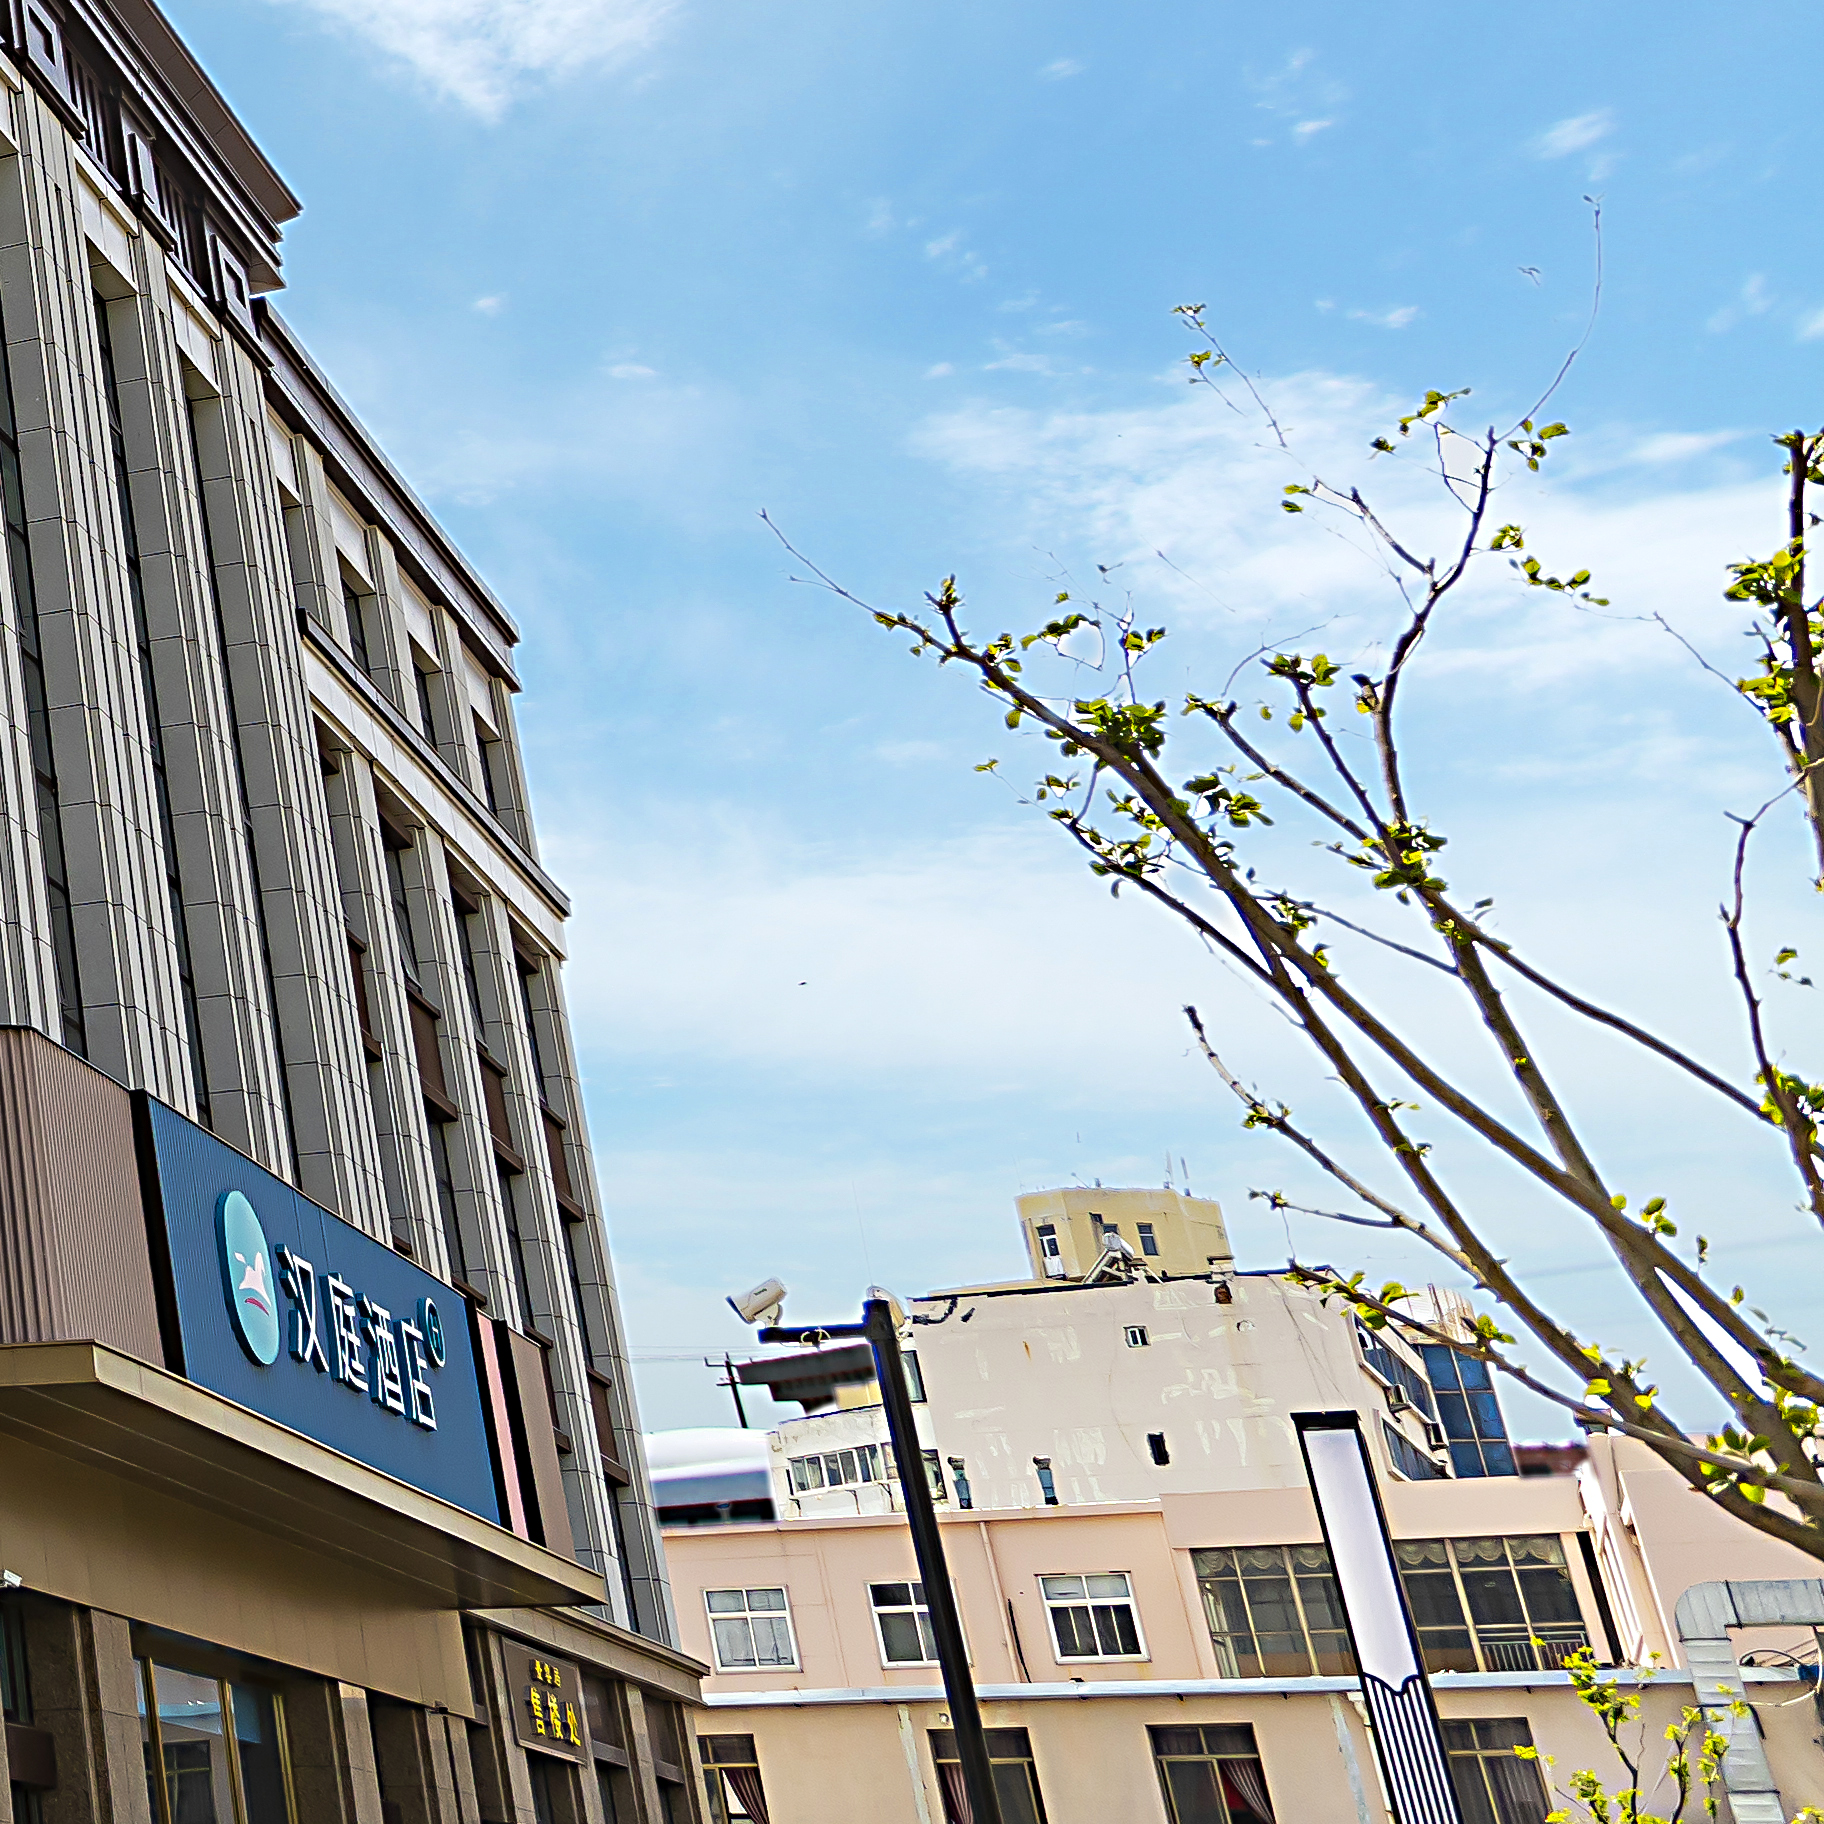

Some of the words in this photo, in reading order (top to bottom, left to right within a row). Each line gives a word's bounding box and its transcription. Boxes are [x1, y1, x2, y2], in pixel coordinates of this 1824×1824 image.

[277, 1245, 438, 1431] 汉庭酒店
[529, 1687, 582, 1747] 售楼处
